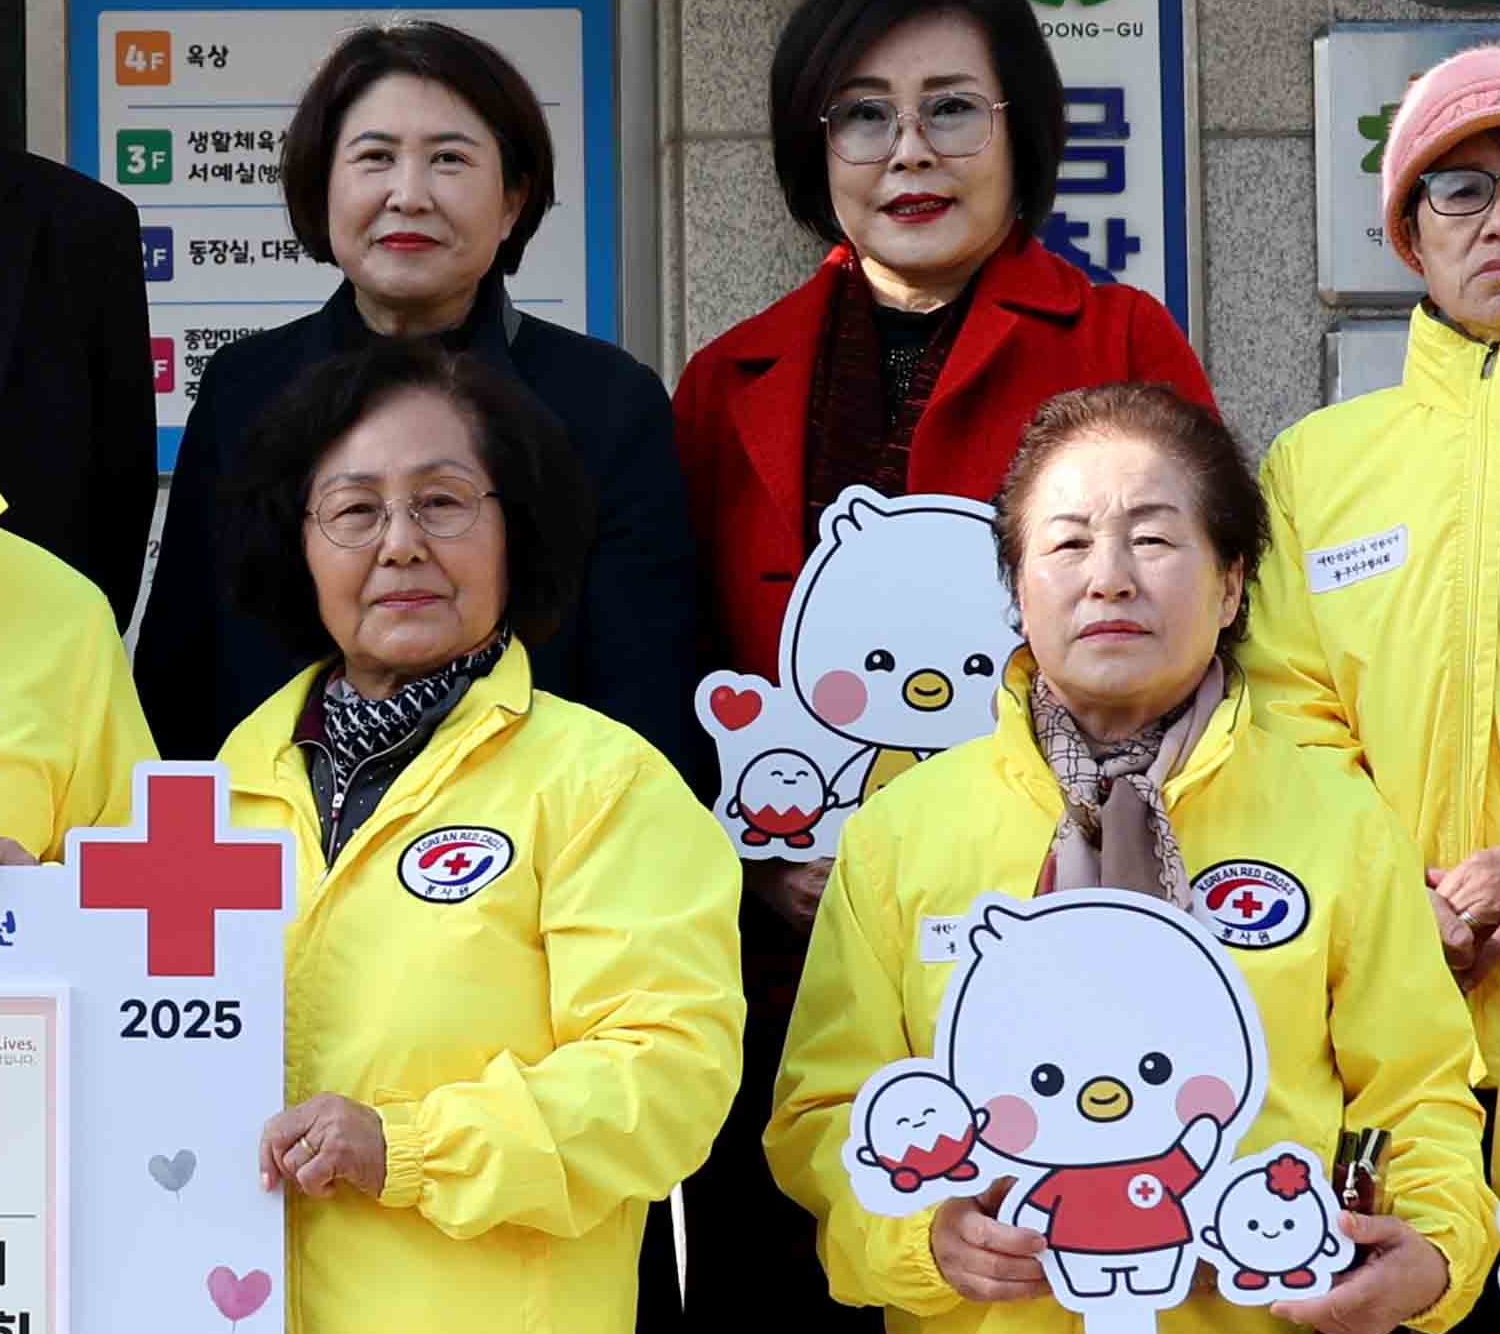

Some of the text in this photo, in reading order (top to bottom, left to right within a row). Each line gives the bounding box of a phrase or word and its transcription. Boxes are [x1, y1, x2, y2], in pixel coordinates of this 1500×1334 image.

[122, 43, 166, 72] 4F
[186, 43, 229, 70] 옥상
[187, 130, 288, 155] 생활체육
[126, 144, 167, 175] 3F
[1196, 867, 1239, 893] KOREAN
[1239, 867, 1262, 879] RED
[119, 999, 243, 1040] 2025
